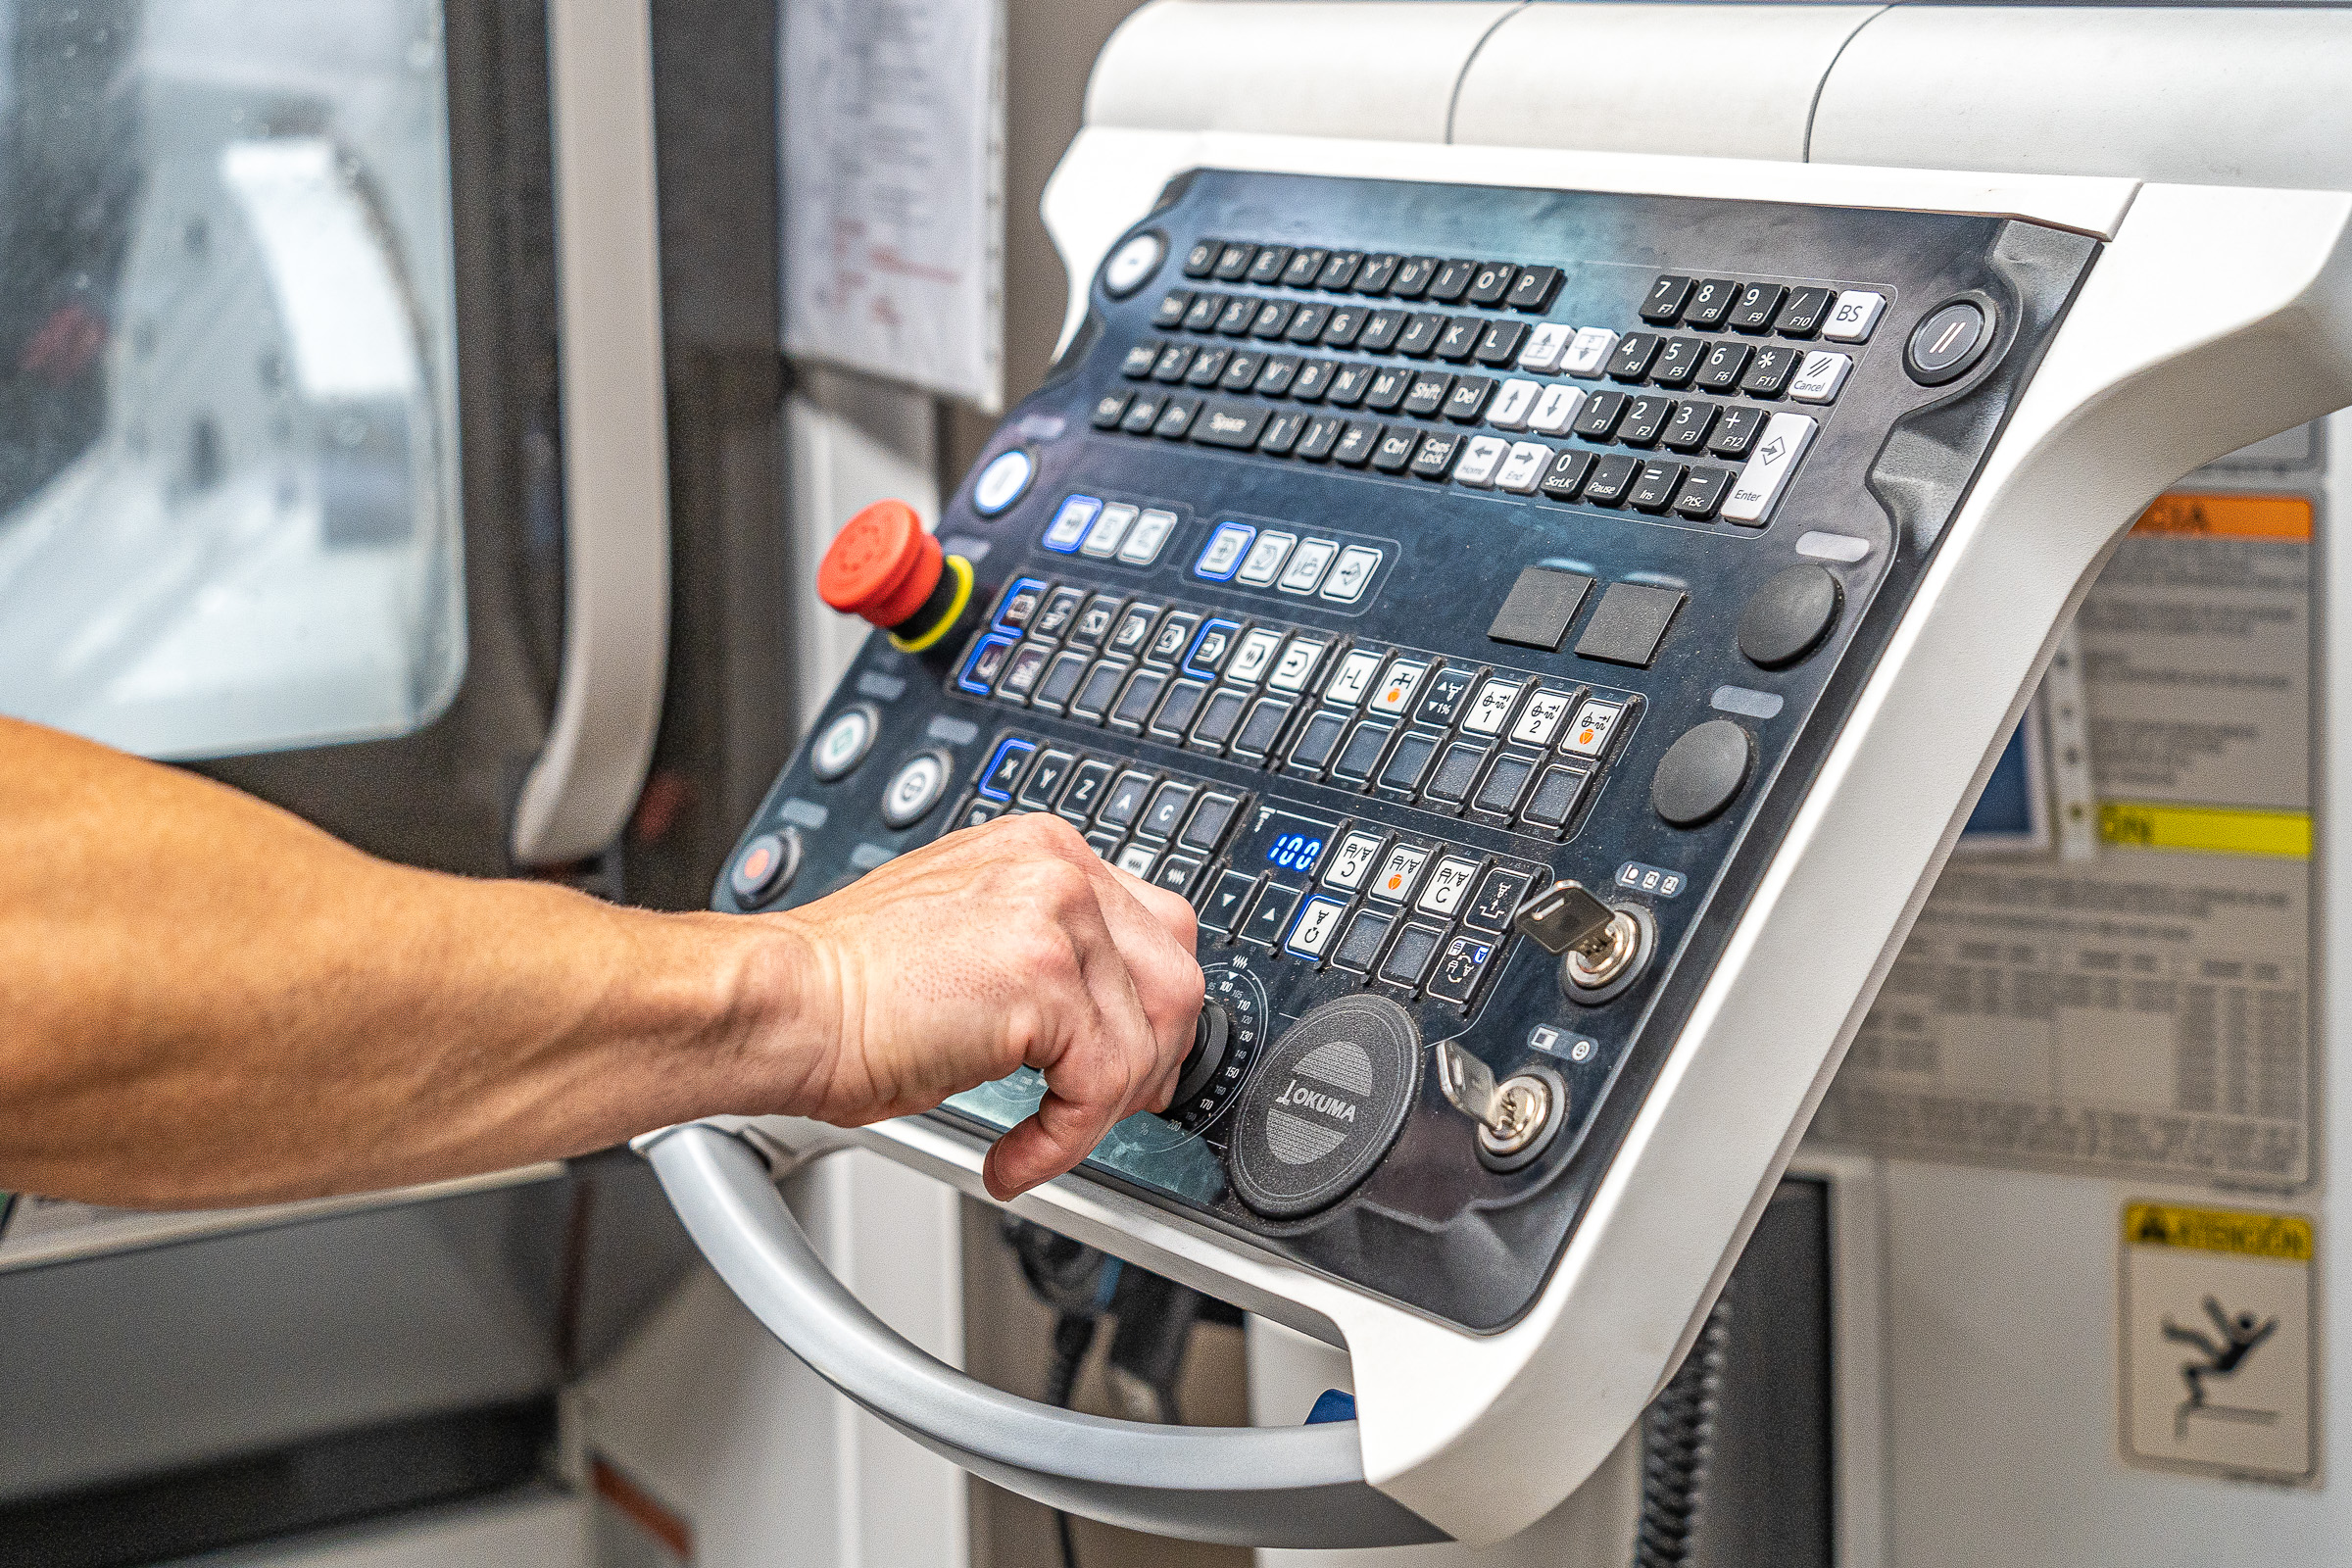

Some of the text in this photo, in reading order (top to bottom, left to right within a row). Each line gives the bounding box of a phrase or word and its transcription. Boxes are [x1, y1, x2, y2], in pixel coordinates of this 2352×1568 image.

[1329, 258, 1346, 275] T
[1365, 261, 1382, 279] Y
[1400, 264, 1419, 282] U
[1478, 271, 1495, 289] O
[1518, 275, 1535, 292] P
[1654, 281, 1671, 298] 7
[1698, 285, 1715, 303] 8
[1743, 289, 1760, 306] 9
[1226, 303, 1244, 321] S
[1658, 304, 1673, 314] F7
[1702, 308, 1718, 318] F8
[1747, 313, 1763, 322] F9
[1837, 305, 1863, 322] BS
[1297, 310, 1314, 327] F
[1333, 314, 1349, 332] G
[1369, 318, 1387, 335] H
[1789, 317, 1811, 326] F10
[1406, 322, 1423, 340] J
[1446, 325, 1464, 344] K
[1486, 329, 1498, 348] L
[1622, 338, 1638, 356] 4
[1665, 343, 1682, 361] 5
[1710, 347, 1727, 366] 6
[1231, 358, 1249, 376] C
[1267, 362, 1284, 380] V
[1625, 361, 1641, 371] F4
[1669, 367, 1685, 376] F5
[1337, 371, 1356, 390] N
[1373, 374, 1396, 394] M
[1714, 371, 1730, 381] F6
[1755, 376, 1777, 386] F11
[1411, 382, 1442, 401] Shift
[1793, 380, 1826, 392] Cancel
[1453, 387, 1479, 404] Del
[1591, 396, 1603, 414] 1
[1631, 401, 1647, 419] 2
[1676, 406, 1692, 424] 3
[1725, 412, 1741, 429] +
[1592, 419, 1606, 429] F1
[1636, 426, 1651, 436] F2
[1681, 431, 1696, 441] F3
[1722, 436, 1744, 447] F12
[1383, 437, 1409, 455] Ctrl
[1425, 438, 1451, 454] Caps
[1418, 450, 1445, 465] Lock
[1556, 454, 1572, 472] 0
[1505, 470, 1525, 480] End
[1644, 469, 1662, 480] =
[1589, 482, 1616, 494] Pause
[1640, 489, 1655, 500] Ins
[1735, 489, 1762, 502] Enter
[1437, 703, 1451, 715] 1%
[1484, 710, 1492, 723] 1
[1529, 719, 1542, 734] 2
[999, 759, 1019, 779] X
[1040, 768, 1056, 788] Y
[1076, 779, 1096, 800] Z
[1117, 793, 1132, 810] A
[1159, 805, 1174, 821] C
[1269, 835, 1321, 871] 100
[1219, 980, 1234, 993] 100
[1231, 989, 1244, 1000] 105
[1237, 1000, 1251, 1011] 110
[1241, 1014, 1253, 1025] 120
[1239, 1030, 1253, 1043] 130
[1235, 1049, 1248, 1059] 140
[1225, 1065, 1240, 1078] 150
[1200, 1098, 1214, 1110] 170
[1293, 1087, 1356, 1123] OKUMA
